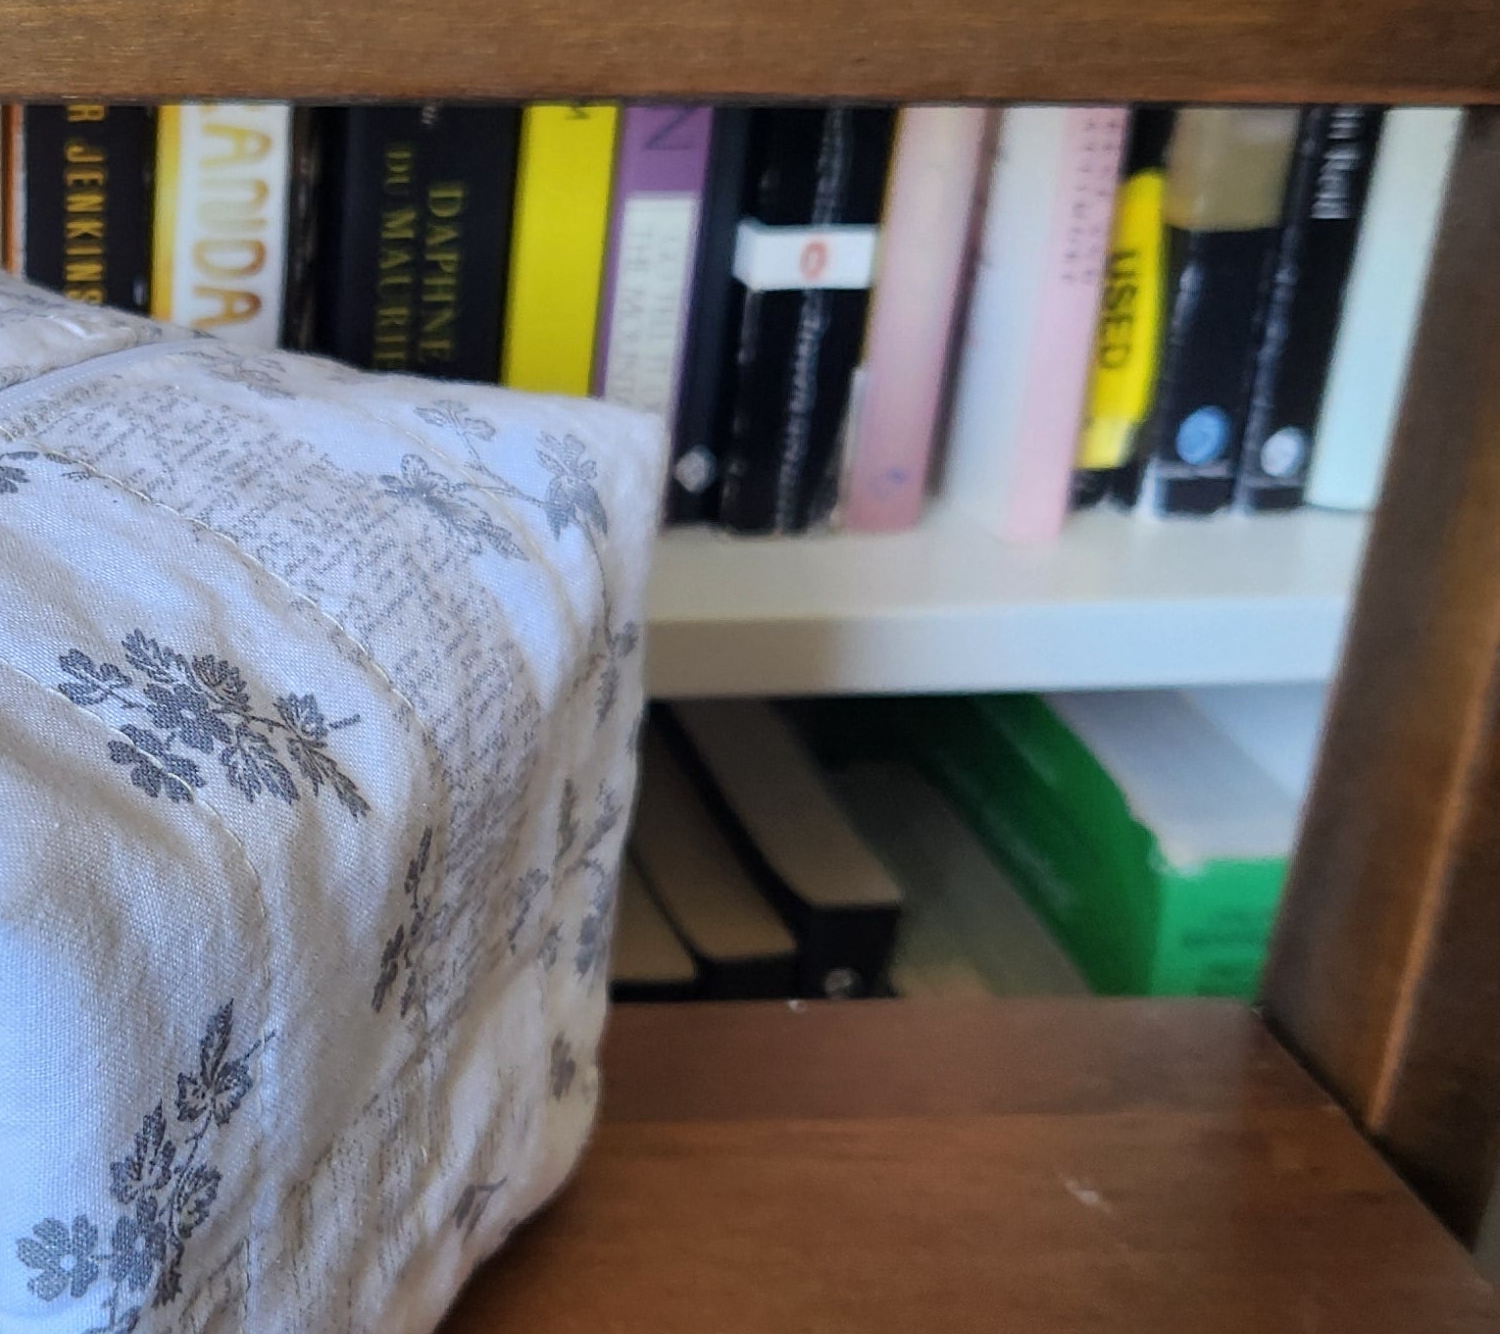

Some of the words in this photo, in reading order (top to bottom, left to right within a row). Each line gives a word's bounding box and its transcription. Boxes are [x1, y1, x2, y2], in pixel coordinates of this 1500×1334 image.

[63, 136, 107, 305] JENKINS
[192, 117, 274, 329] ANDA
[418, 181, 467, 365] DAPHNE
